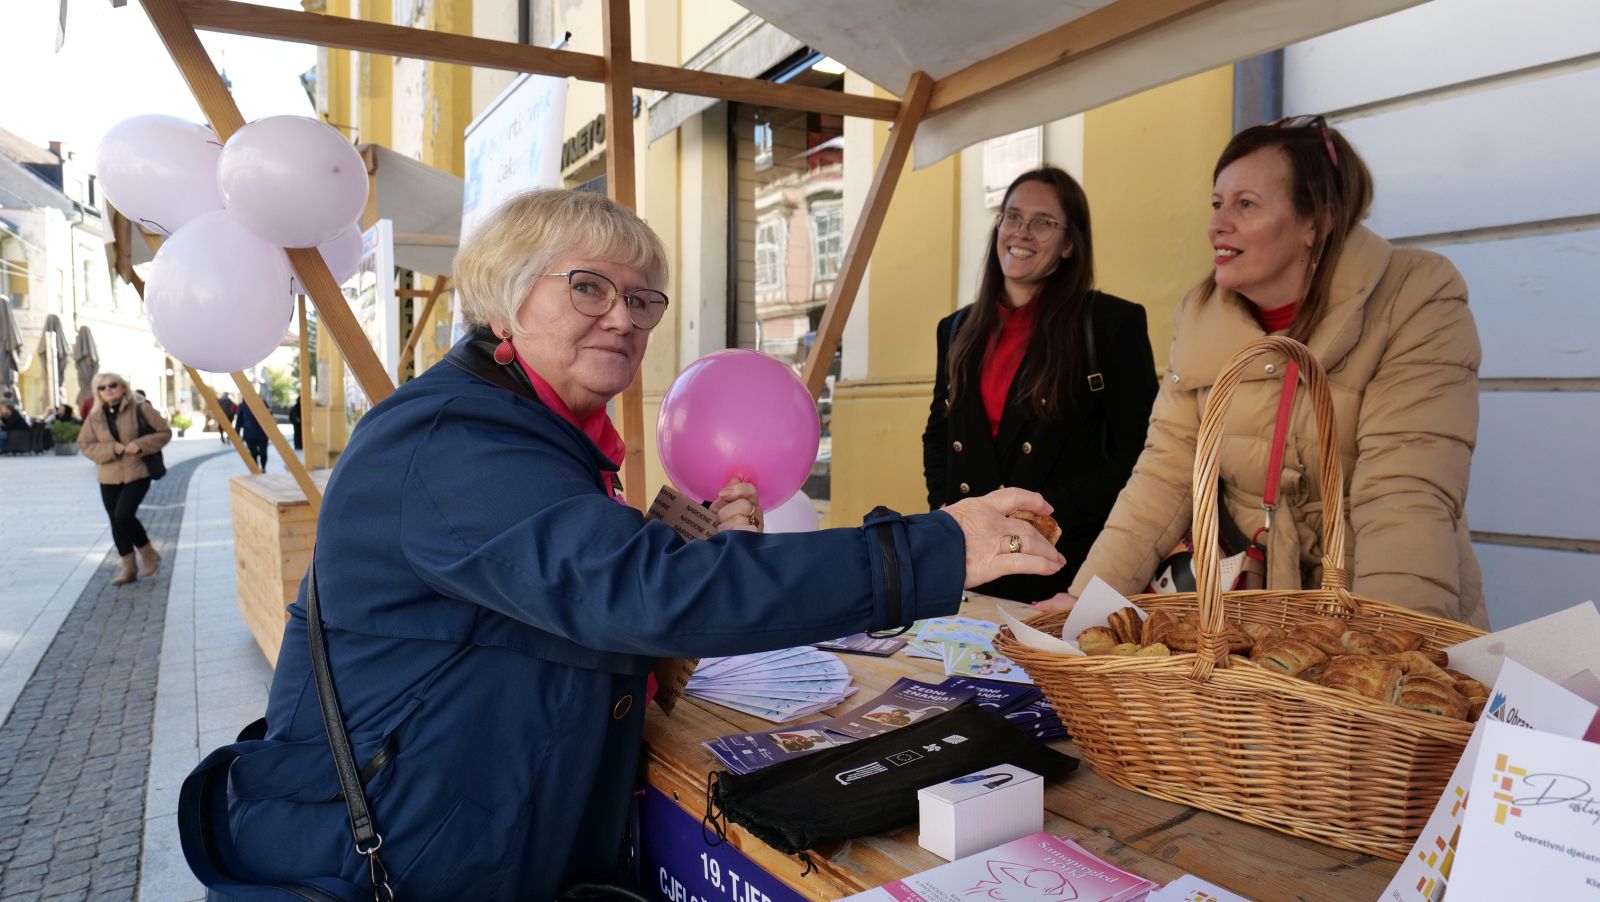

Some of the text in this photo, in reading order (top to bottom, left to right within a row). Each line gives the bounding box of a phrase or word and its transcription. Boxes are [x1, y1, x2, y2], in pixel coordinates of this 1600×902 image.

[1514, 830, 1565, 853] Operativni
[700, 852, 772, 902] 19. TJE
[1038, 842, 1120, 883] Samopregled
